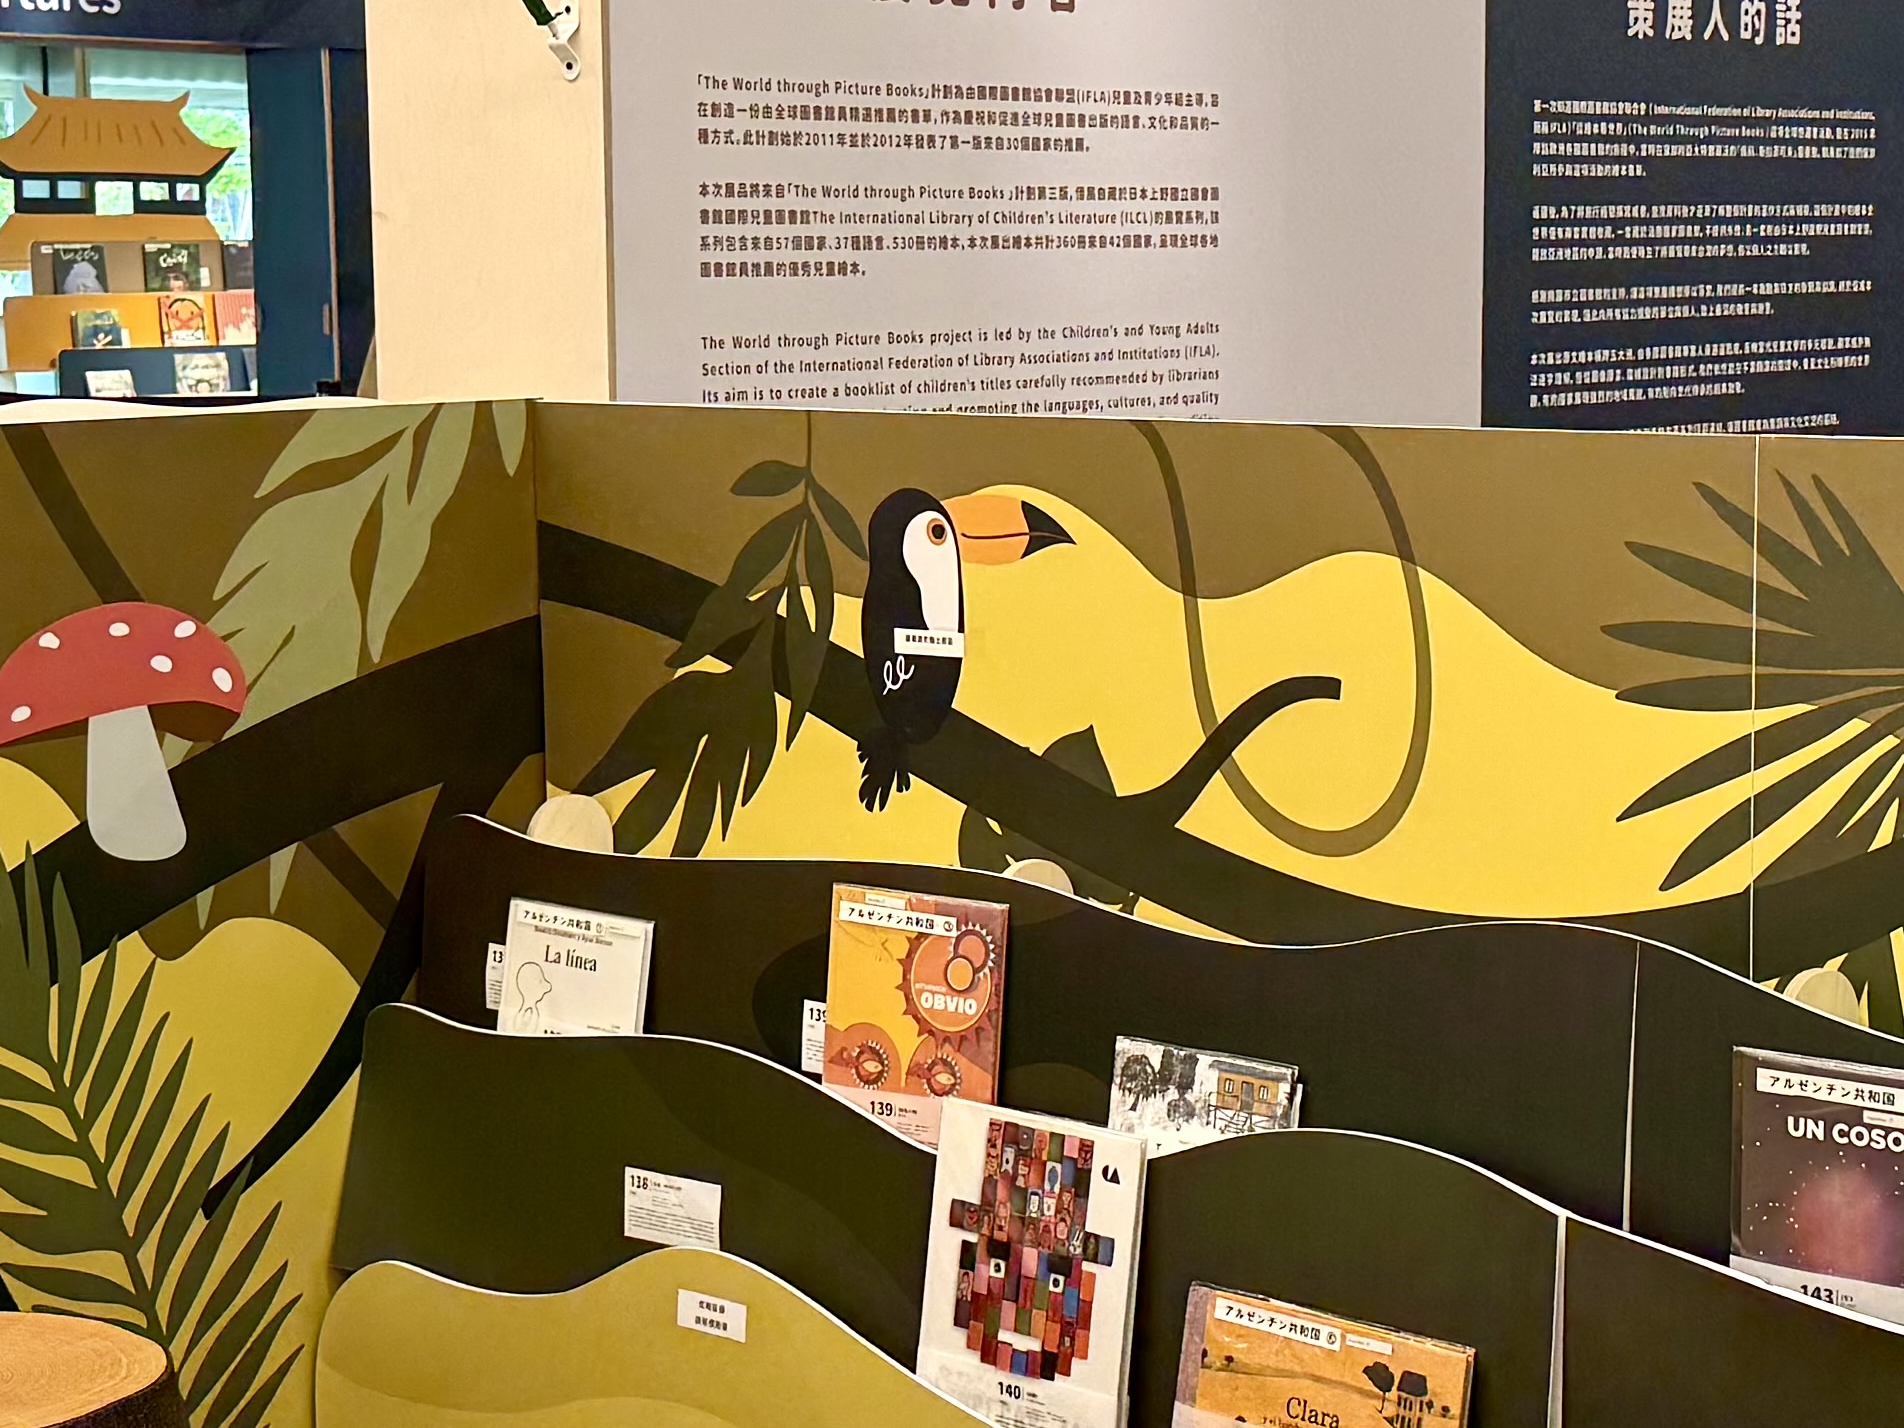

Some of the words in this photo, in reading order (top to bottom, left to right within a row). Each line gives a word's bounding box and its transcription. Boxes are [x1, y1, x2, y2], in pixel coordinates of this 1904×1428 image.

[733, 77, 772, 92] World
[777, 79, 830, 97] through
[834, 81, 882, 97] Picture
[822, 185, 859, 200] World
[864, 185, 915, 203] through
[919, 185, 964, 200] Picture
[969, 185, 1005, 201] Books
[840, 210, 925, 225] International
[929, 211, 972, 228] Library
[978, 211, 990, 225] of
[993, 210, 1055, 225] Children's
[1058, 210, 1117, 225] Literature
[701, 335, 725, 350] The
[732, 334, 771, 349] World
[777, 333, 829, 350] through
[836, 332, 881, 347] Picture
[887, 330, 924, 345] Books
[930, 328, 973, 346] project
[978, 328, 988, 342] is
[994, 327, 1012, 342] led
[1018, 326, 1032, 343] by
[1037, 326, 1056, 340] the
[1062, 324, 1118, 340] Children's
[1124, 323, 1144, 337] and
[1149, 323, 1181, 339] Young
[1186, 321, 1220, 335] Adults
[702, 362, 751, 377] Section
[756, 360, 769, 375] of
[774, 360, 795, 373] the
[799, 357, 884, 373] International
[888, 355, 953, 370] Federation
[958, 353, 969, 367] of
[973, 352, 1015, 368] Library
[1019, 349, 1090, 365] Associations
[1094, 348, 1114, 362] and
[1117, 346, 1180, 361] Institutions
[702, 389, 719, 403] Its
[724, 388, 748, 402] aim
[753, 387, 764, 401] is
[770, 386, 782, 400] to
[788, 384, 827, 400] create
[832, 385, 839, 397] a
[844, 383, 896, 397] booklist
[900, 381, 912, 395] of
[917, 378, 976, 394] children's
[981, 377, 1012, 391] titles
[1016, 374, 1067, 391] carefully
[1071, 371, 1147, 386] recommended
[1152, 370, 1165, 385] by
[1168, 369, 1220, 383] librarians
[1021, 400, 1040, 414] the
[1044, 398, 1104, 415] languages,
[1108, 395, 1156, 410] cultures,
[1159, 393, 1179, 406] and
[1182, 391, 1220, 406] quality
[493, 950, 504, 964] 13
[544, 945, 561, 964] La
[566, 948, 597, 972] línea
[920, 991, 978, 1015] OBVIO
[1768, 1075, 1896, 1107] アルゼンチン共和国
[870, 1100, 893, 1117] 139
[1787, 1115, 1825, 1141] UN
[1225, 1305, 1321, 1342] アルゼンチン共和国
[998, 1381, 1021, 1400] 140
